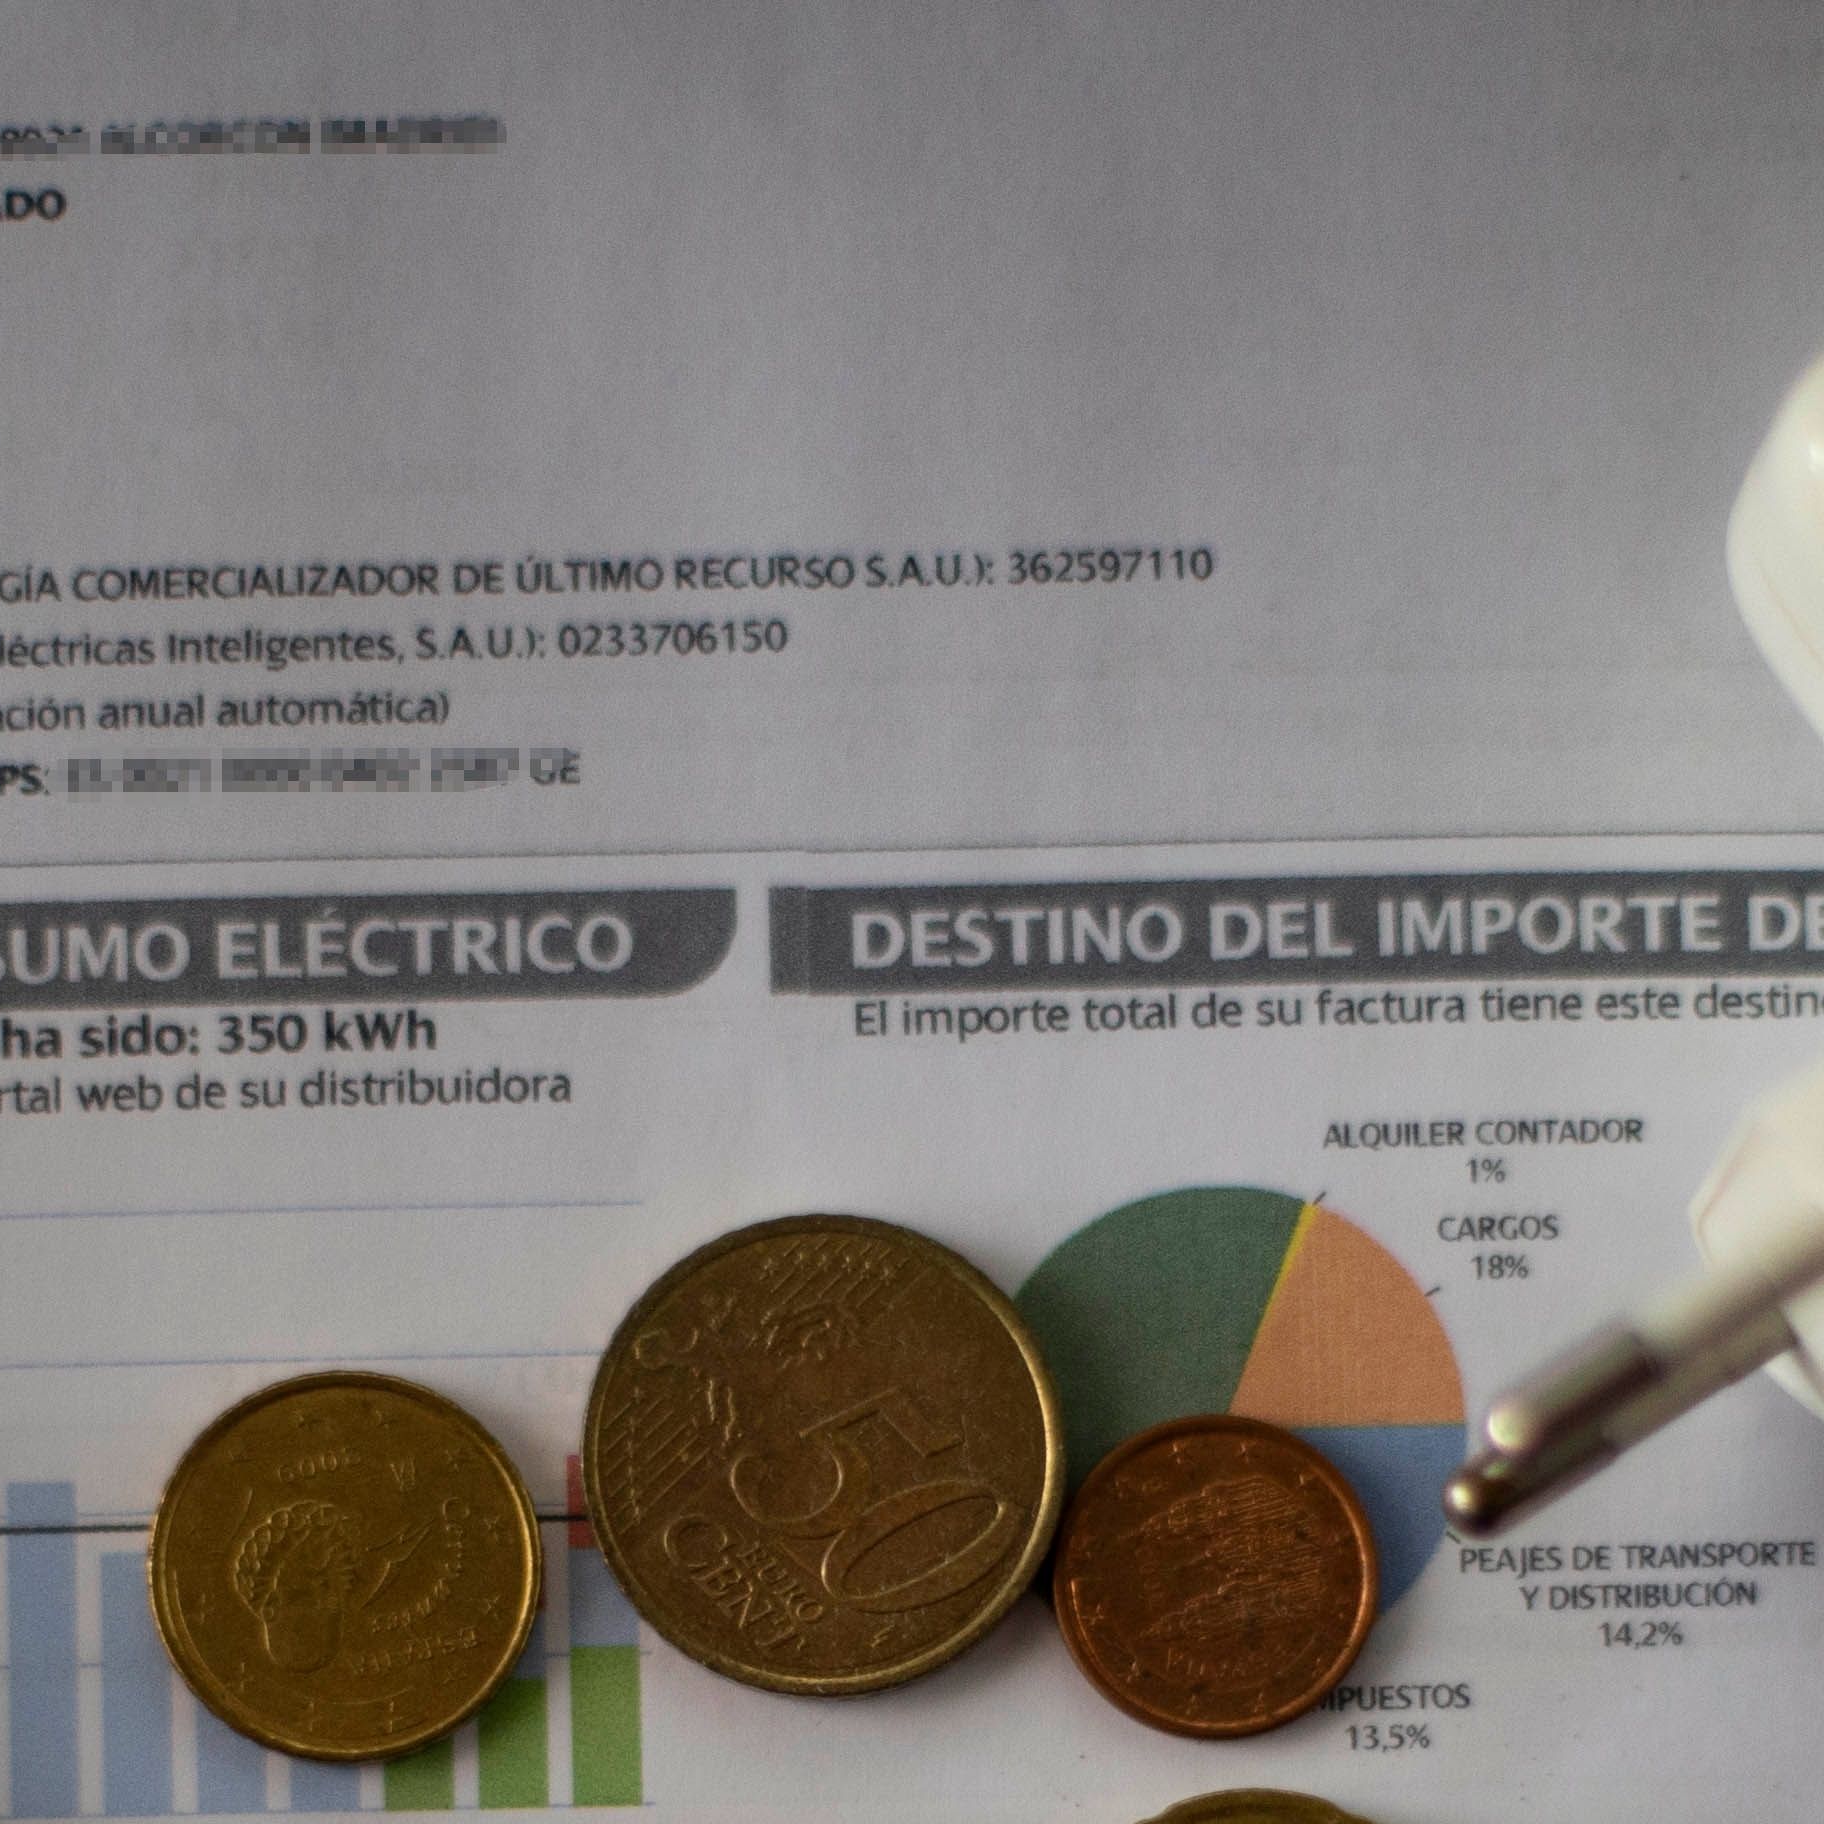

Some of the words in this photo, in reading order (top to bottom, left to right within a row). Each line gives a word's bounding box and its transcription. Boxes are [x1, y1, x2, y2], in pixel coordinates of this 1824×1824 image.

[215, 906, 634, 979] ELÉCTRICO
[852, 902, 1184, 968] DESTINO
[1209, 900, 1354, 960] DEL
[1378, 892, 1723, 956] IMPORTE
[854, 989, 888, 1037] El
[902, 999, 1071, 1043] importe
[1082, 983, 1178, 1032] total
[1190, 982, 1244, 1029] de
[1256, 998, 1303, 1028] su
[1316, 978, 1467, 1025] factura
[1480, 987, 1584, 1022] tiene
[1595, 987, 1682, 1021] este
[0, 1017, 62, 1058] ha
[79, 1013, 199, 1058] sido:
[218, 1013, 308, 1054] 350
[323, 1008, 437, 1051] kWh
[1323, 1120, 1466, 1149] ALQUILER
[1475, 1118, 1644, 1145] CONTADOR
[1467, 1156, 1507, 1183] 1%
[1437, 1213, 1560, 1242] CARGOS
[1472, 1253, 1530, 1280] 18%
[1455, 1536, 1564, 1579] PEAJES
[1572, 1544, 1611, 1572] DE
[1621, 1540, 1815, 1569] TRANSPORTE
[1520, 1586, 1540, 1611] Y
[1548, 1578, 1760, 1611] DISTRIBUCIÓN
[1600, 1621, 1685, 1649] 14,2%
[1341, 1714, 1433, 1752] 13,5%
